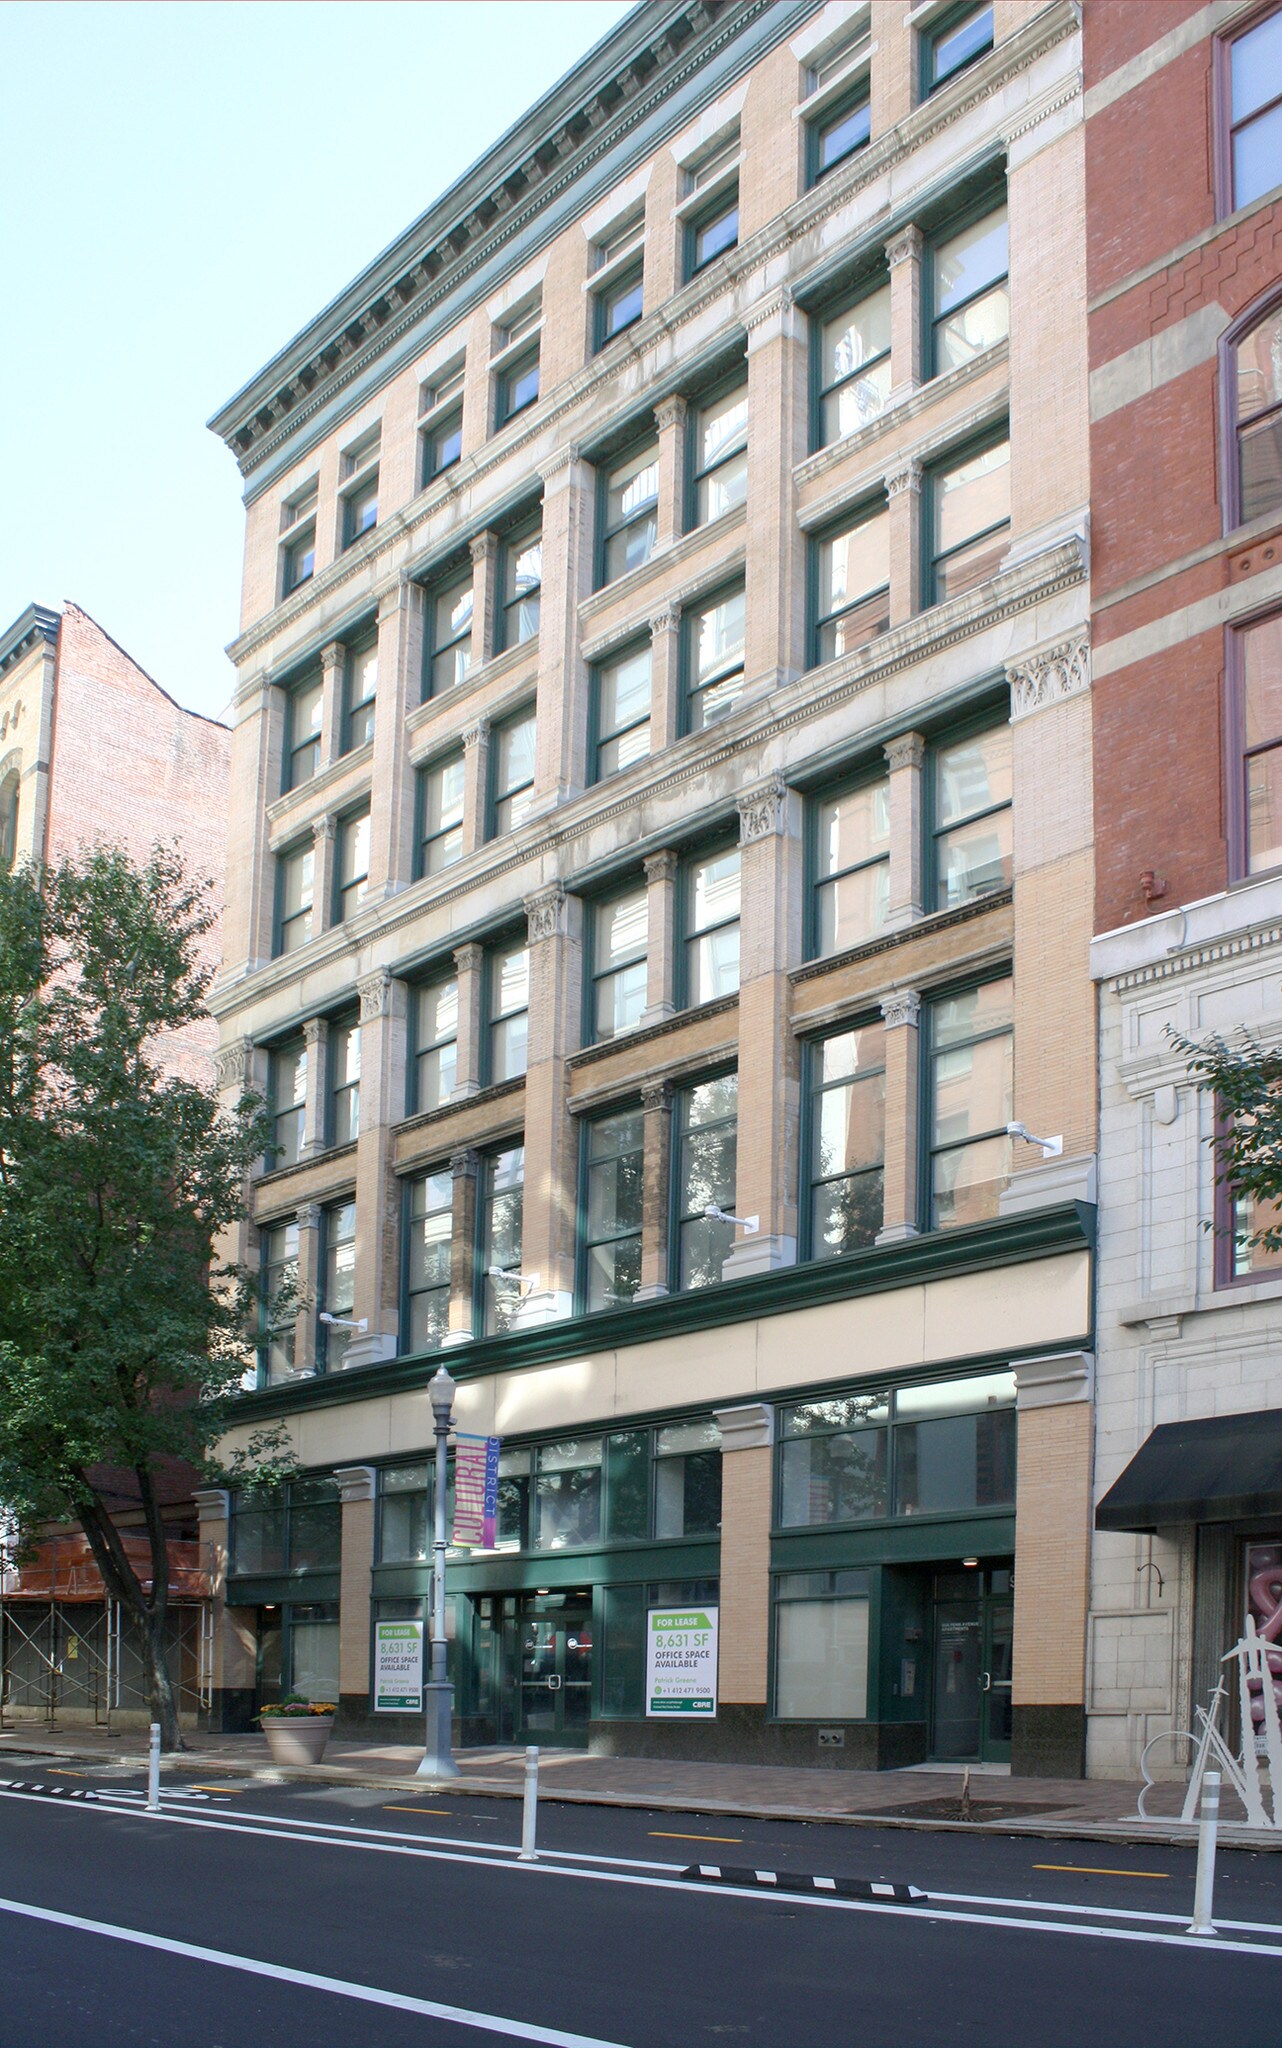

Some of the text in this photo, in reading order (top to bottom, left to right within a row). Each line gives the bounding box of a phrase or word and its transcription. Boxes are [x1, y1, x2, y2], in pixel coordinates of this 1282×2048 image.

[485, 1436, 500, 1516] DISTRICT
[452, 1442, 488, 1544] CULTURAL
[656, 1618, 698, 1627] FOR LEASE
[656, 1633, 709, 1649] 8,631 SF
[380, 1642, 418, 1655] 8,631 SF
[380, 1656, 400, 1664] OFFICE
[655, 1650, 710, 1660] OFFICE SPACE
[655, 1660, 698, 1668] AVAILABLE
[672, 1686, 683, 1694] 412
[683, 1686, 695, 1694] 471
[695, 1686, 711, 1694] 9500
